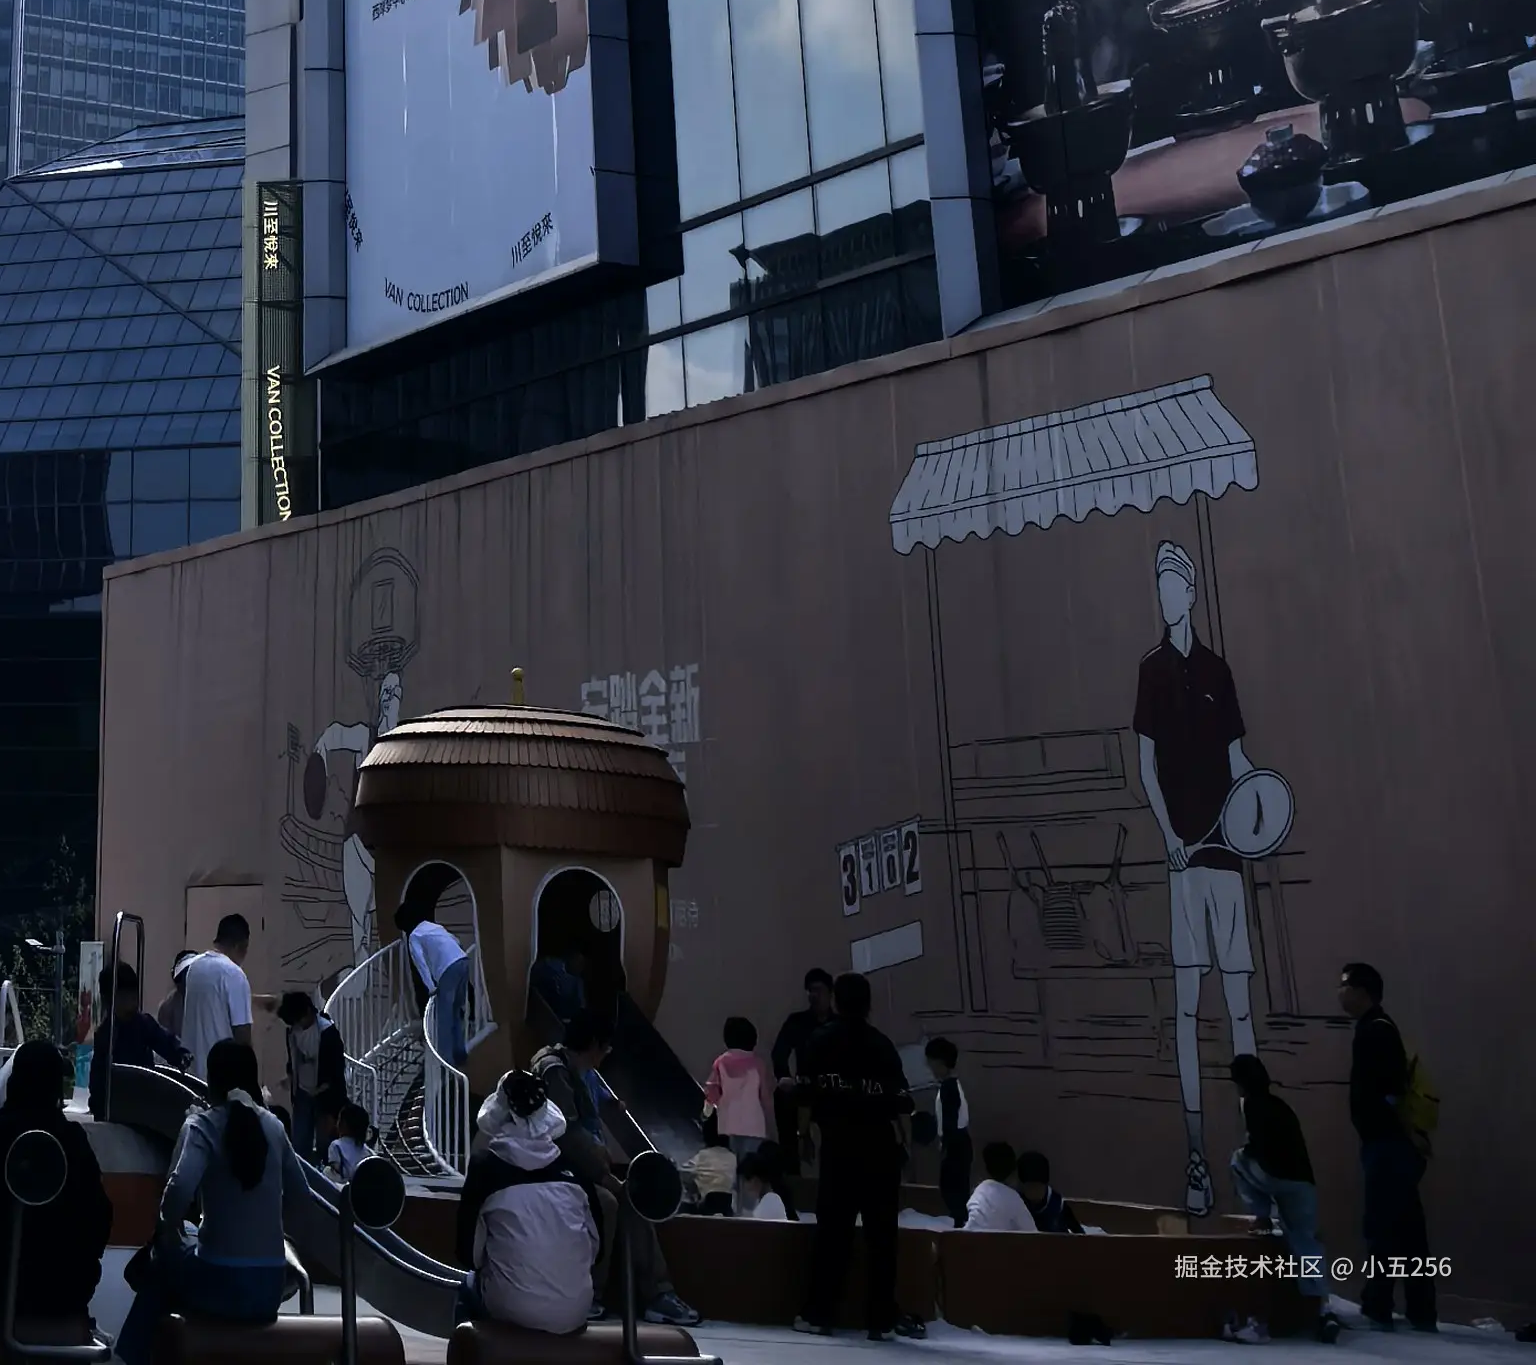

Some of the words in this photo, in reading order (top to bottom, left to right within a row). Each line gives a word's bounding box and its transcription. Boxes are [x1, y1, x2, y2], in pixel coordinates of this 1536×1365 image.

[384, 277, 403, 307] VAN
[407, 281, 470, 313] COLLECTION
[267, 364, 281, 404] VAN
